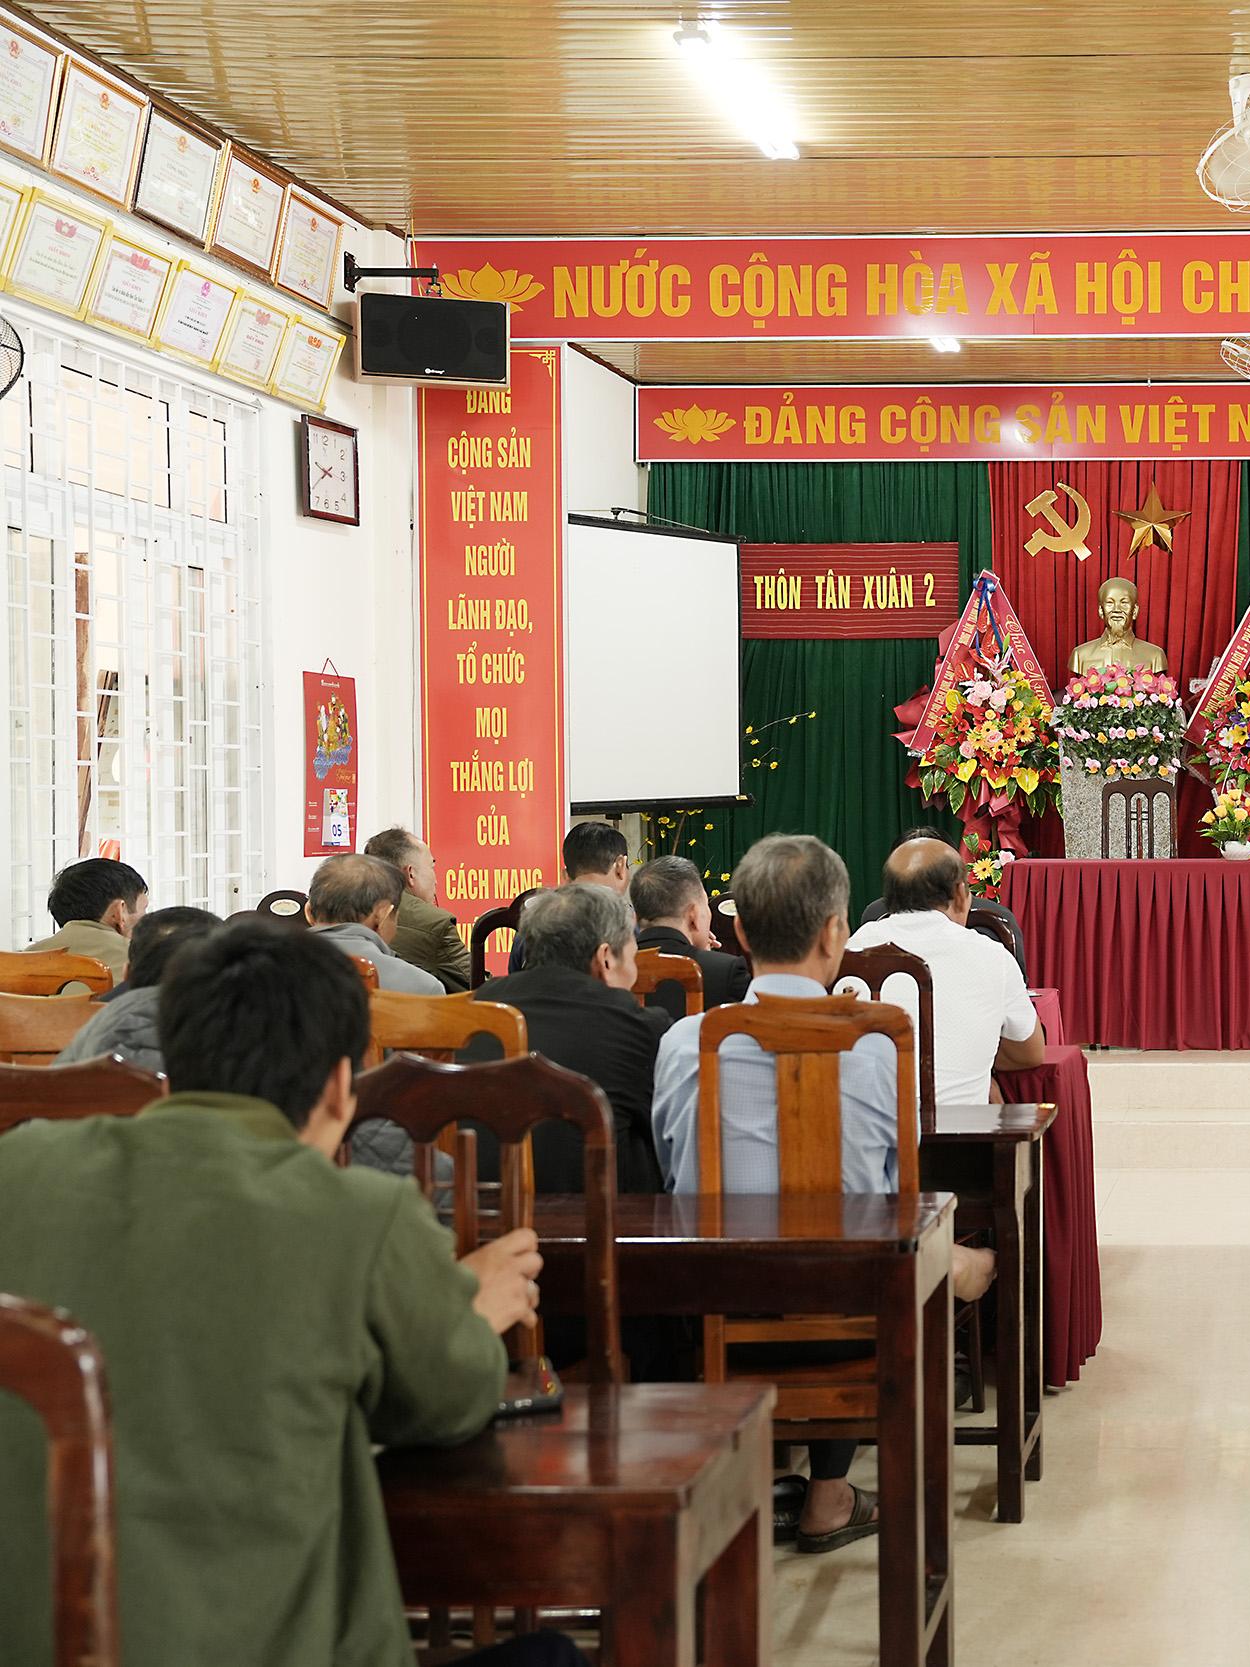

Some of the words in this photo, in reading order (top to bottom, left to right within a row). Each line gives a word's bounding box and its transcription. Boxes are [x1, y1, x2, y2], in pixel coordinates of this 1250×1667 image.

[553, 248, 692, 318] NƯỚC
[709, 252, 847, 328] CỘNG
[866, 251, 970, 316] HÒA
[986, 251, 1058, 316] XÃ
[1075, 248, 1162, 325] HỘI
[743, 392, 866, 445] ĐẢNG
[880, 396, 1001, 452] CỘNG
[1014, 391, 1107, 445] SẢN
[1119, 395, 1217, 451] VIỆT
[339, 449, 346, 461] 2
[448, 431, 493, 473] CỘNG
[497, 427, 531, 468] SẢN
[340, 471, 346, 482] 3
[323, 498, 330, 510] 6
[334, 500, 340, 511] 5
[450, 485, 486, 529] VIỆT
[490, 491, 528, 522] NAM
[465, 537, 515, 577] NGƯỜI
[753, 567, 802, 610] THÔN
[815, 568, 850, 609] TÂN
[862, 567, 914, 610] XUÂN
[923, 572, 936, 607] 2
[448, 593, 491, 631] LÃNH
[495, 598, 533, 637] ĐẠO,
[456, 641, 478, 685] TỔ
[481, 646, 525, 685] CHỨC
[475, 706, 507, 746] MỌI
[450, 754, 504, 792] THẮNG
[508, 757, 534, 797] LỢI
[331, 824, 343, 837] 05
[476, 804, 510, 846] CỦA
[445, 862, 490, 900] CÁCH
